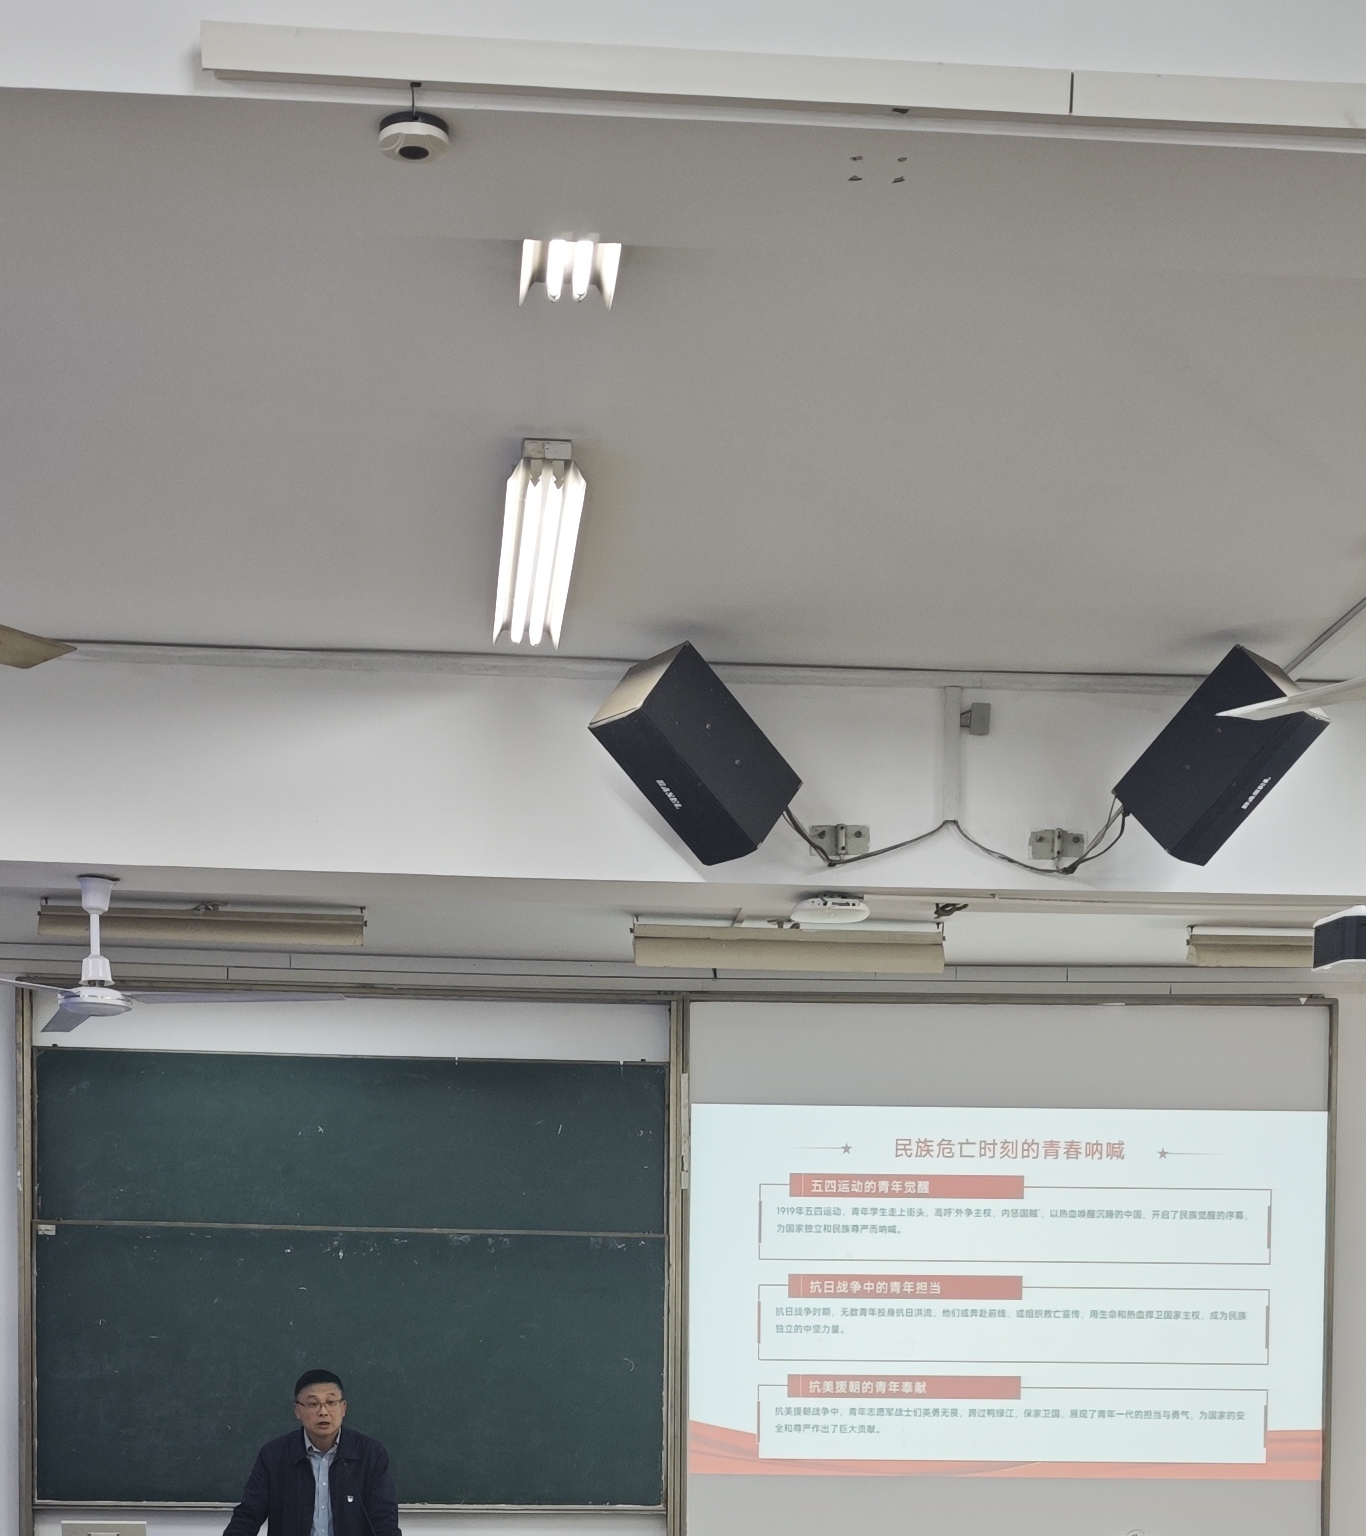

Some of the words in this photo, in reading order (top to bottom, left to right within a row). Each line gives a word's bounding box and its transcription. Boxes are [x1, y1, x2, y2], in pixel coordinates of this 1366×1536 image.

[895, 1137, 1126, 1160] 民族危亡时刻的青春呐喊
[811, 1179, 931, 1194] 五四运动的青年觉醒
[776, 1223, 902, 1235] 为国家独立和民族尊严而呐喊。
[809, 1280, 942, 1295] 抗日战争中的青年担当
[775, 1323, 845, 1335] 独立的中坚力量。
[808, 1380, 927, 1395] 抗美援朝的青年奉献
[775, 1424, 881, 1435] 全和尊严作出了巨大贡献。
